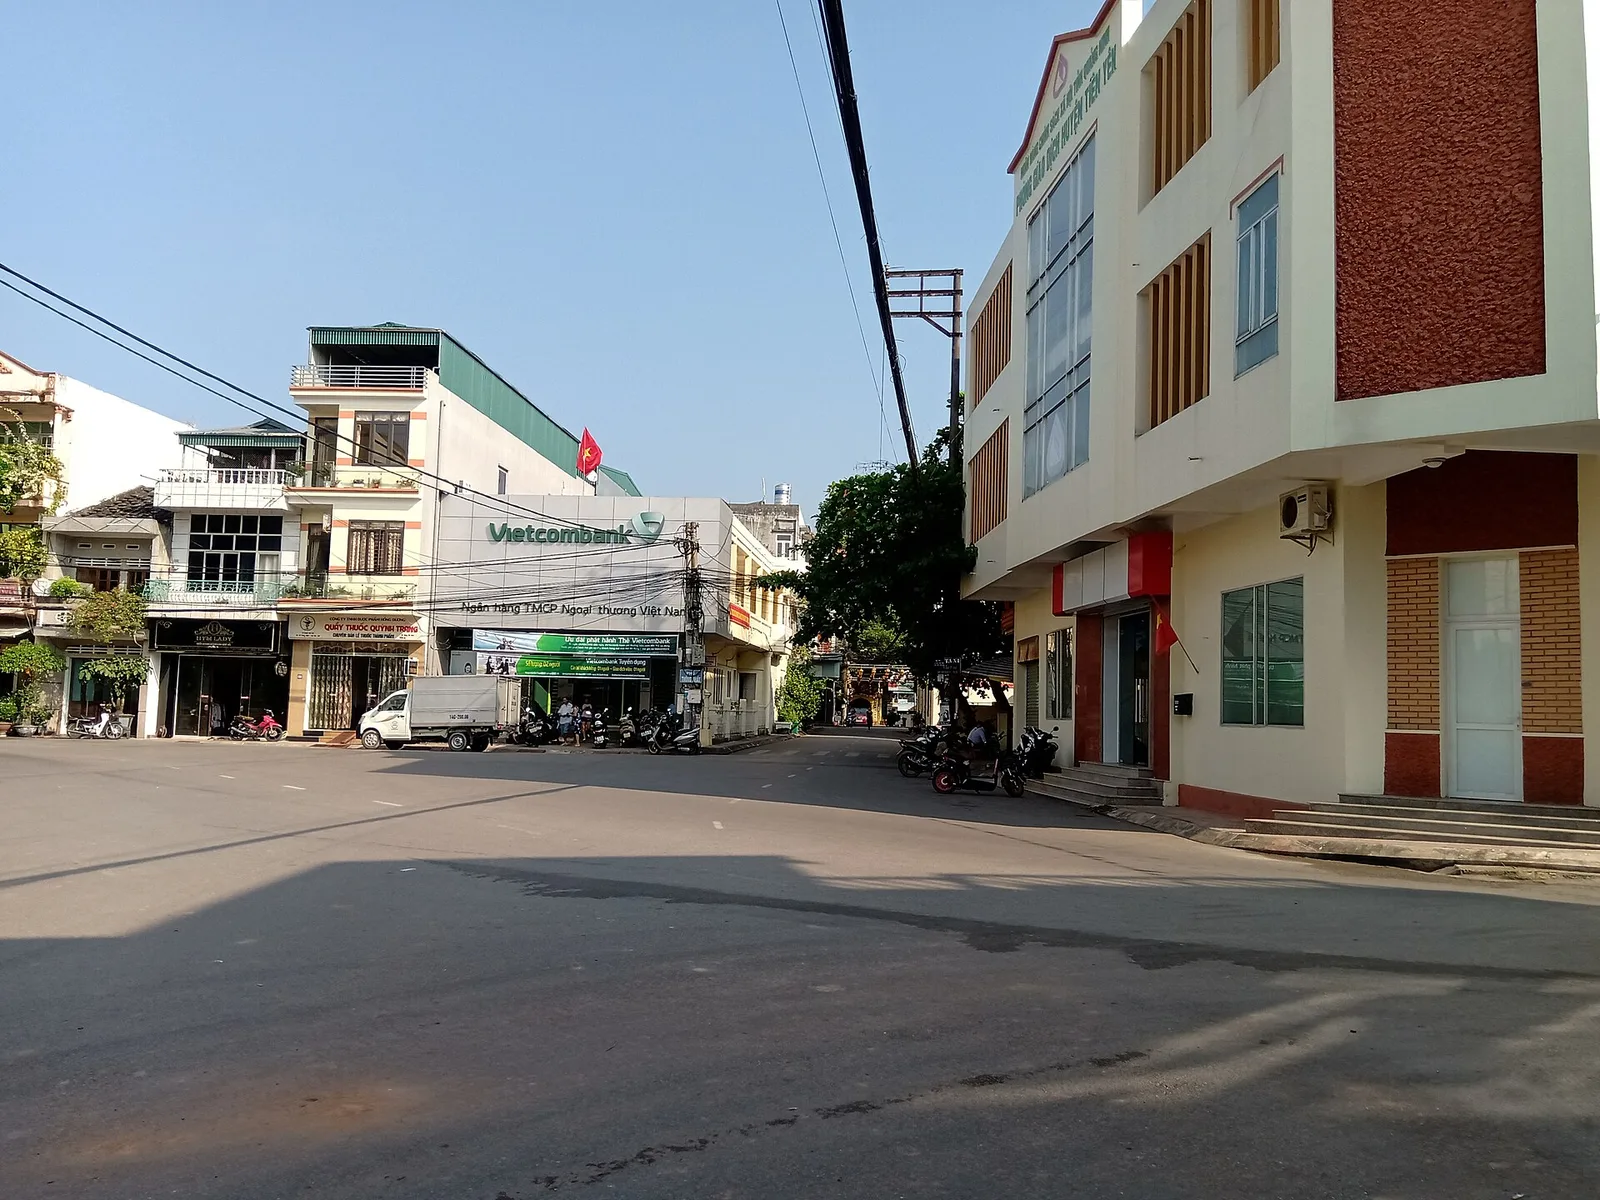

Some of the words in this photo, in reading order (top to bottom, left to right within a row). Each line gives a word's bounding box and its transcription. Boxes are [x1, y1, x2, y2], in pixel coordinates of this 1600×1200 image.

[1103, 44, 1117, 85] YÊN
[489, 523, 633, 544] Vietcombank
[461, 602, 490, 613] Ngân
[494, 603, 521, 614] hàng
[525, 603, 558, 613] TMCP
[561, 605, 593, 616] Ngoại
[640, 606, 662, 617] Việt
[346, 622, 368, 632] THUỐC
[395, 625, 418, 633] TRANG
